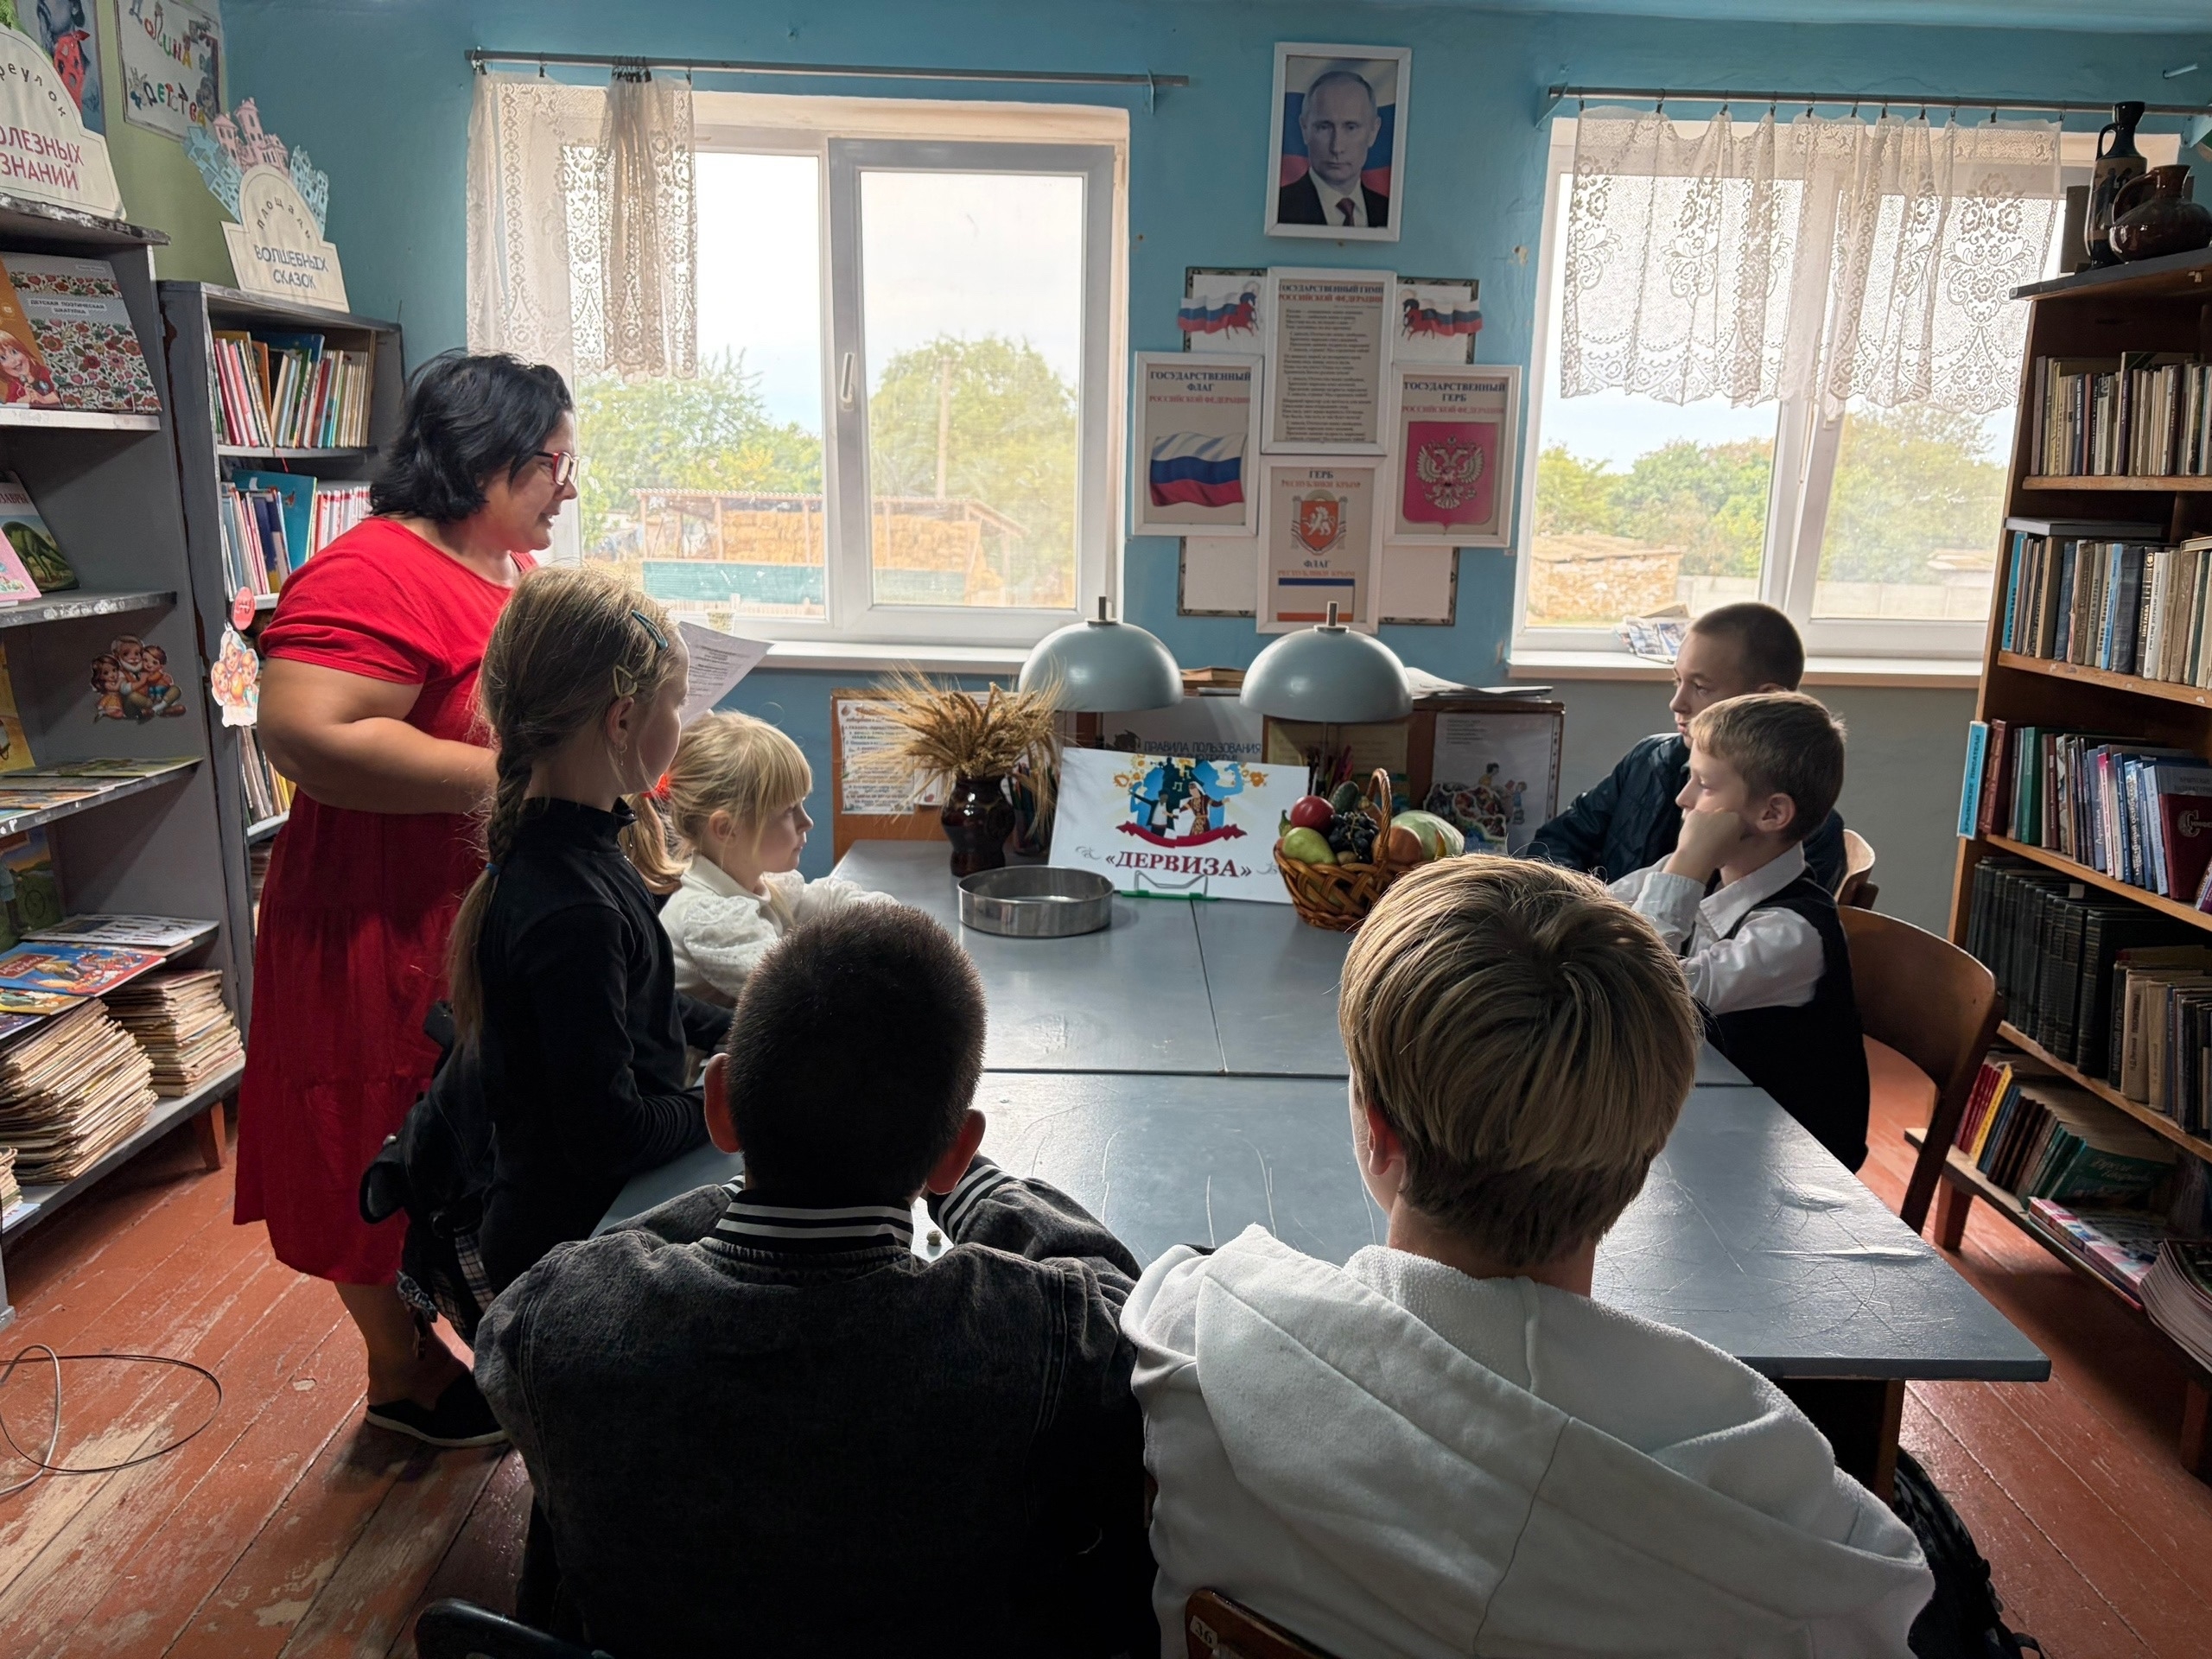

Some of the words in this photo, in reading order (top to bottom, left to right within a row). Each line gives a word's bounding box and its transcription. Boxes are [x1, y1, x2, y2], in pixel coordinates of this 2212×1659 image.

[253, 244, 329, 272] ВОЛШЕБНЫХ
[272, 268, 317, 290] СКАЗОК
[1150, 371, 1251, 381] ГОСУДАРСТВЕННЫЙ
[1187, 382, 1214, 392] ФЛАГ
[1404, 381, 1506, 392] ГОСУДАРСТВЕННЫЙ
[1442, 393, 1467, 403] ГЕРБ
[1309, 470, 1334, 480] ГЕРБ
[1303, 559, 1330, 569] ФЛАГ
[1144, 741, 1189, 753] ПРАВИЛА
[1192, 741, 1262, 754] ПОЛЬЗОВАНИЯ
[1969, 734, 1981, 779] ПИСАТЕЛИ
[1105, 850, 1252, 879] «ДЕРВИЗА»
[1194, 1622, 1213, 1644] 36
